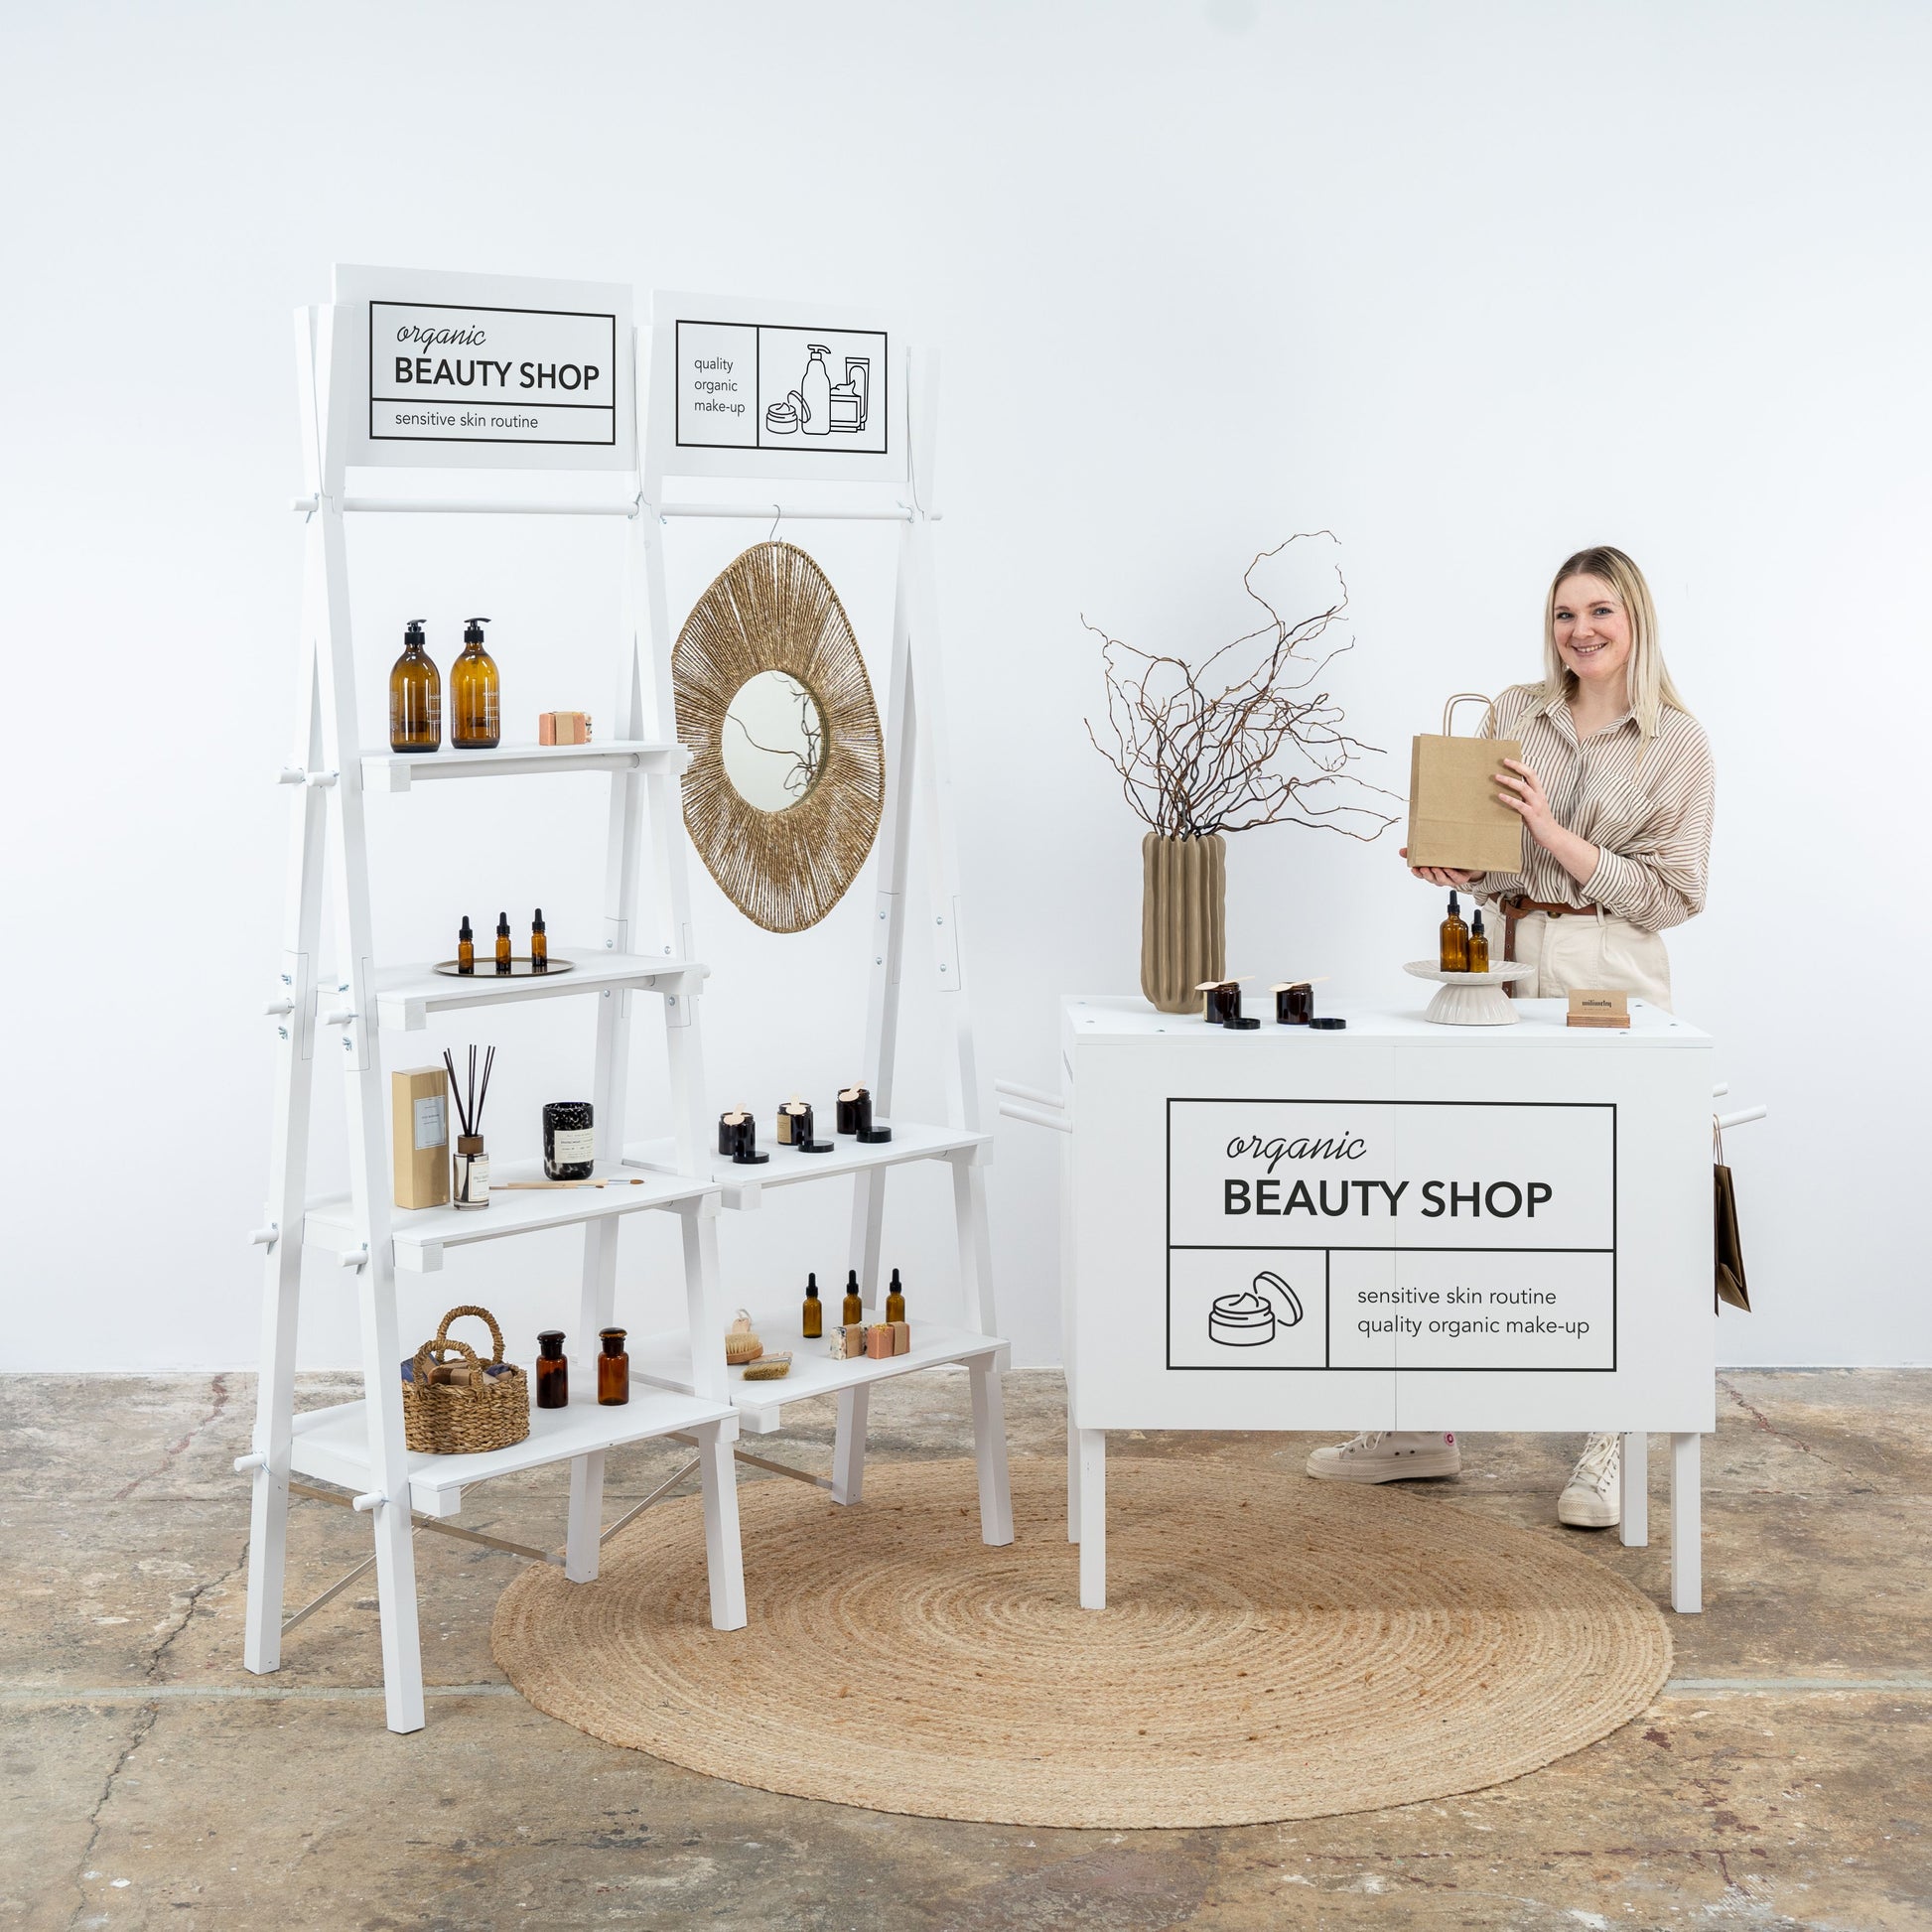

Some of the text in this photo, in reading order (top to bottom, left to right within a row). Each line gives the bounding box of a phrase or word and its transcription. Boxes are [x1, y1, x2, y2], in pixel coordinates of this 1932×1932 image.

[396, 325, 486, 354] organic
[395, 356, 599, 391] BEAUTY SHOP
[694, 356, 734, 374] quality
[694, 378, 738, 395] organic
[694, 399, 745, 417] make-up
[395, 411, 538, 429] sensitive skin routine
[1226, 1130, 1367, 1174] organic
[1224, 1178, 1553, 1218] BEAUTY SHOP
[1357, 1287, 1557, 1306] sensitive skin routine
[1357, 1314, 1590, 1340] quality organic make-up
